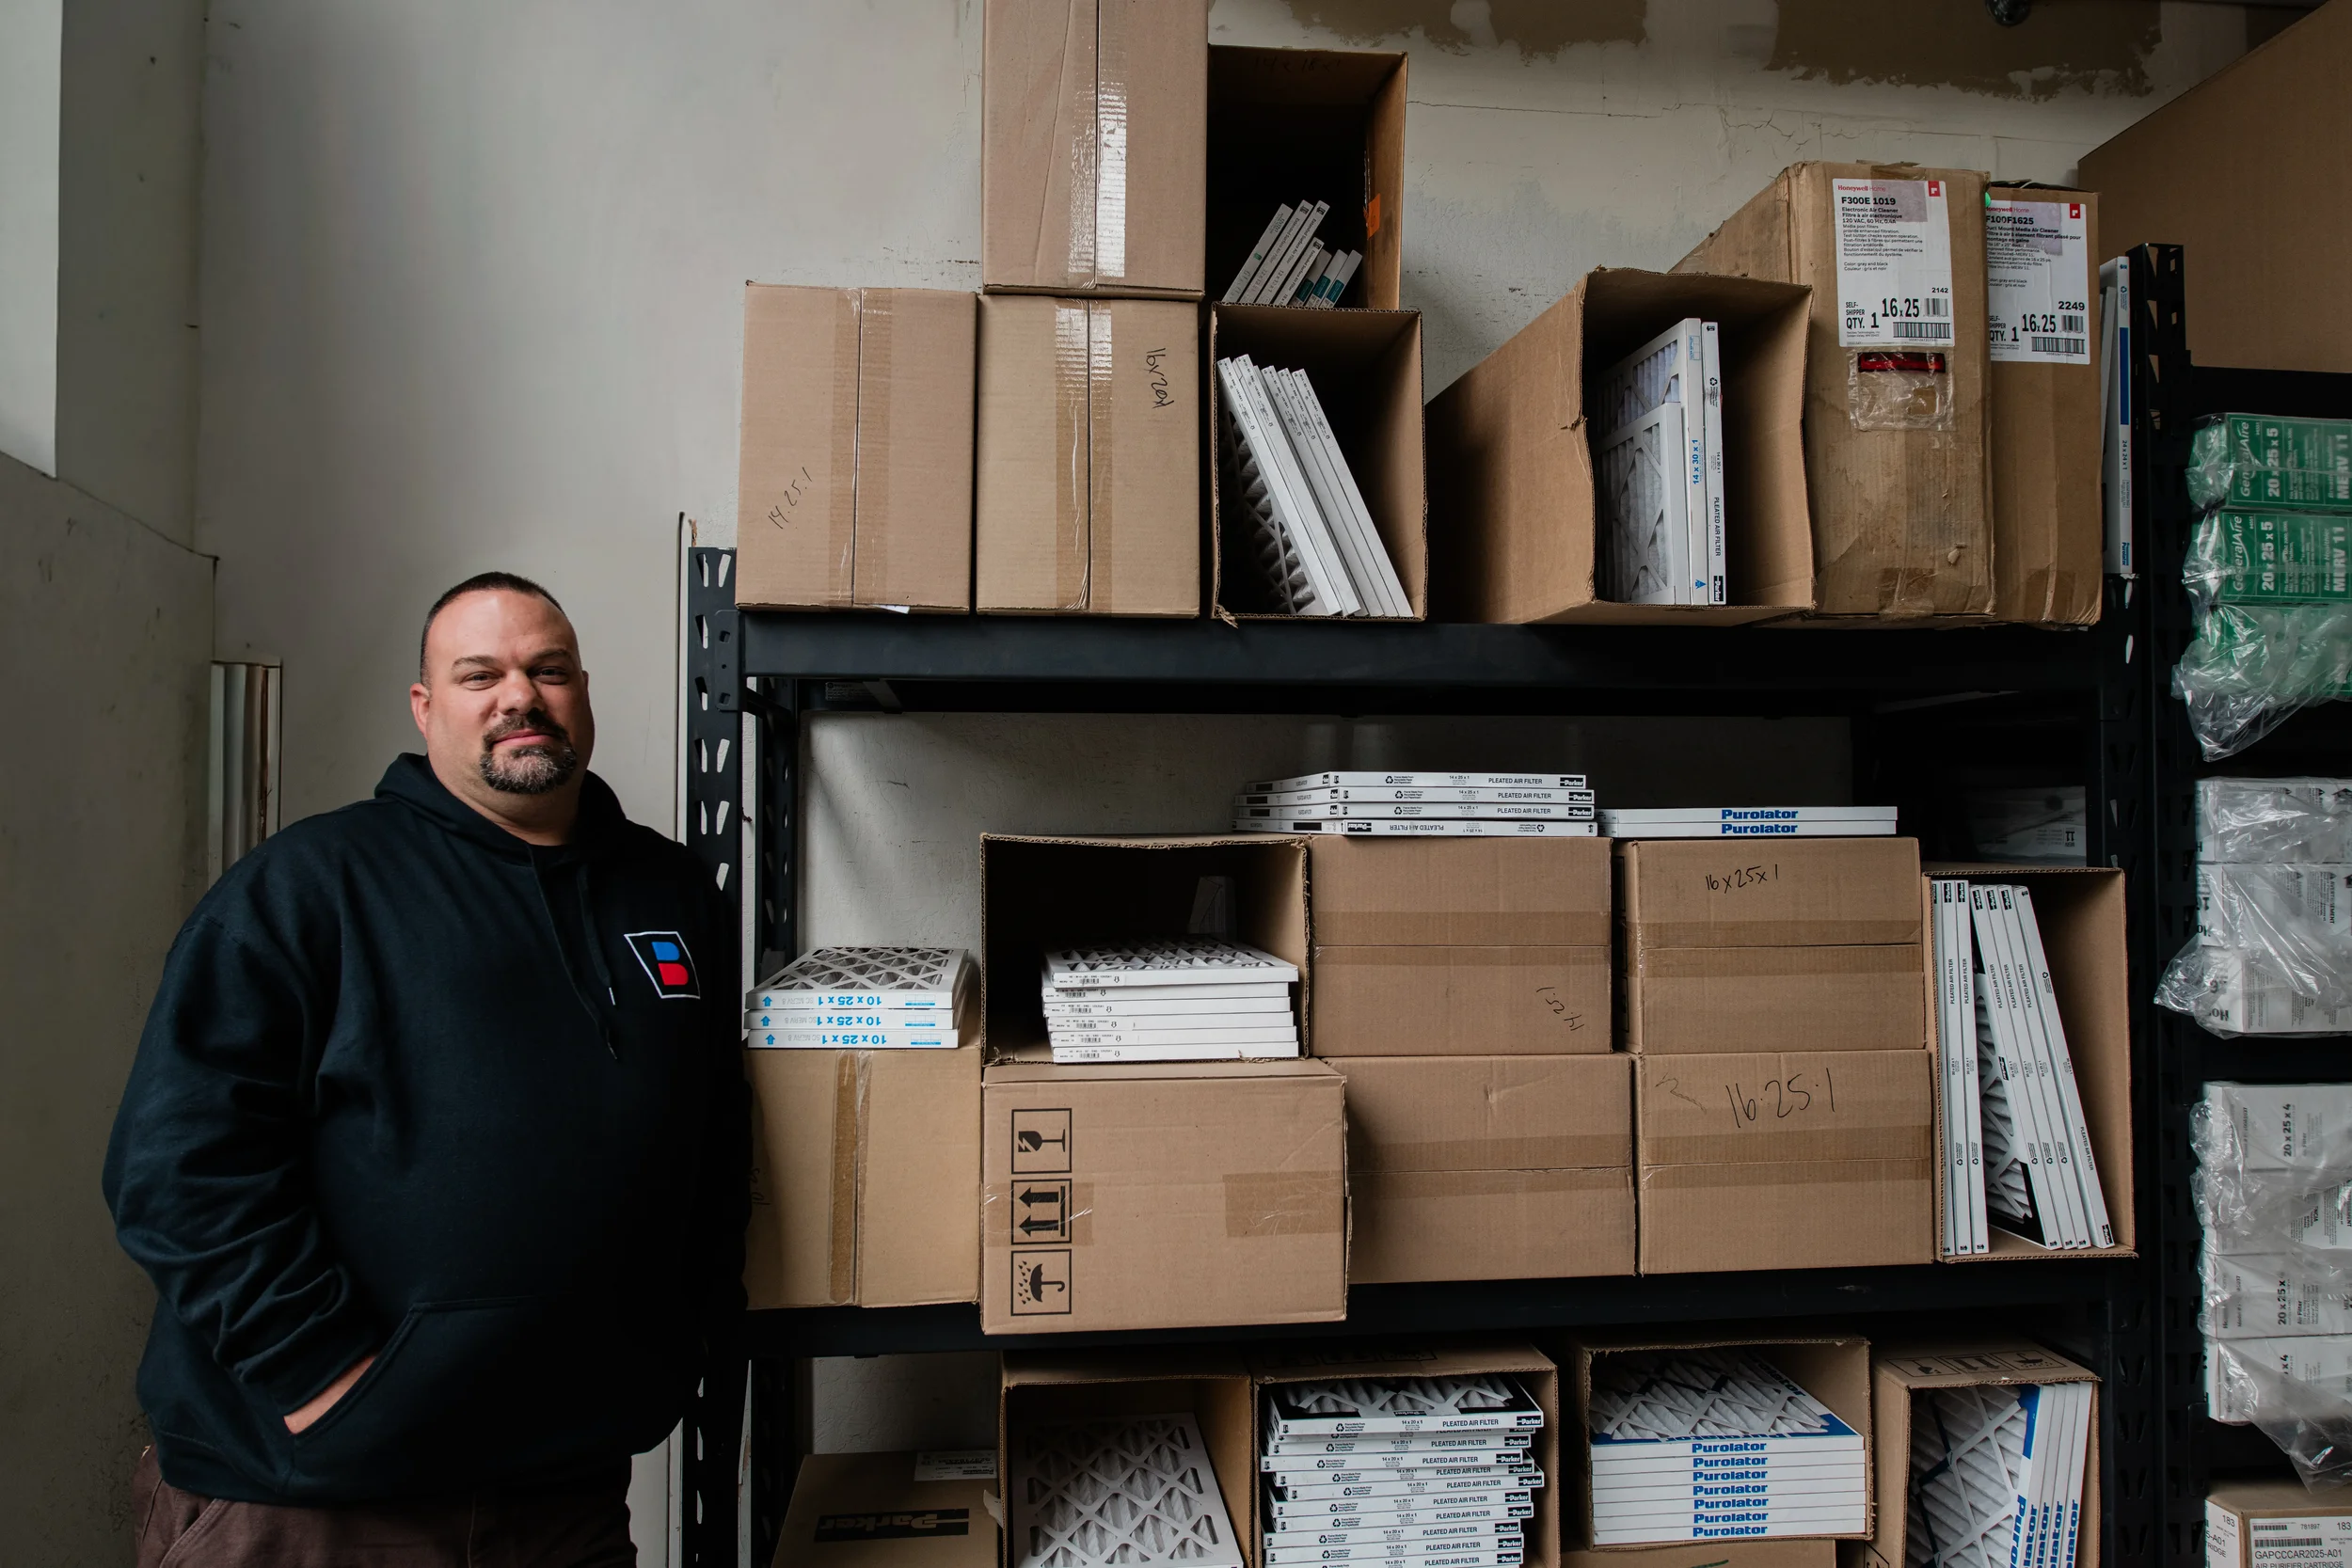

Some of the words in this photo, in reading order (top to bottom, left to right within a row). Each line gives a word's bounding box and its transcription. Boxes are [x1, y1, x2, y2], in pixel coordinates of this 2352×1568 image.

[1873, 197, 1896, 205] 1019
[1986, 215, 2034, 225] F100F1625
[2058, 301, 2085, 311] 2249
[1846, 318, 1865, 330] QTY.
[1871, 312, 1879, 328] 1
[2011, 327, 2019, 342] 1
[2267, 428, 2278, 437] 5
[2336, 435, 2347, 448] 11
[1692, 454, 1699, 465] 30
[2267, 449, 2279, 467] 25
[1693, 474, 1699, 485] 14
[2268, 479, 2280, 497] 20
[2261, 522, 2273, 531] 5
[2333, 527, 2344, 542] 11
[2261, 543, 2274, 560] 25
[2262, 572, 2274, 591] 20
[1721, 809, 1798, 820] Purolator
[1721, 824, 1798, 834] Purolator
[818, 997, 824, 1006] 1
[838, 996, 854, 1006] 25
[867, 996, 882, 1006] 10
[817, 1016, 823, 1026] 1
[837, 1016, 853, 1026] 25
[866, 1017, 882, 1026] 10
[822, 1035, 828, 1045] 1
[842, 1035, 859, 1045] 25
[871, 1035, 887, 1045] 10
[2283, 1121, 2291, 1133] 25
[2284, 1144, 2292, 1157] 20
[1692, 1443, 1766, 1453] Purolator
[1693, 1457, 1768, 1467] Purolator
[1693, 1471, 1767, 1481] Purolator
[1693, 1485, 1768, 1495] Purolator
[1694, 1498, 1768, 1509] Purolator
[820, 1513, 938, 1531] Parker
[1694, 1513, 1768, 1523] Purolator
[2222, 1515, 2235, 1527] 183
[2337, 1522, 2351, 1530] 183
[1693, 1526, 1767, 1537] Purolator
[2255, 1549, 2342, 1559] GAPCCCAR2025-A01
